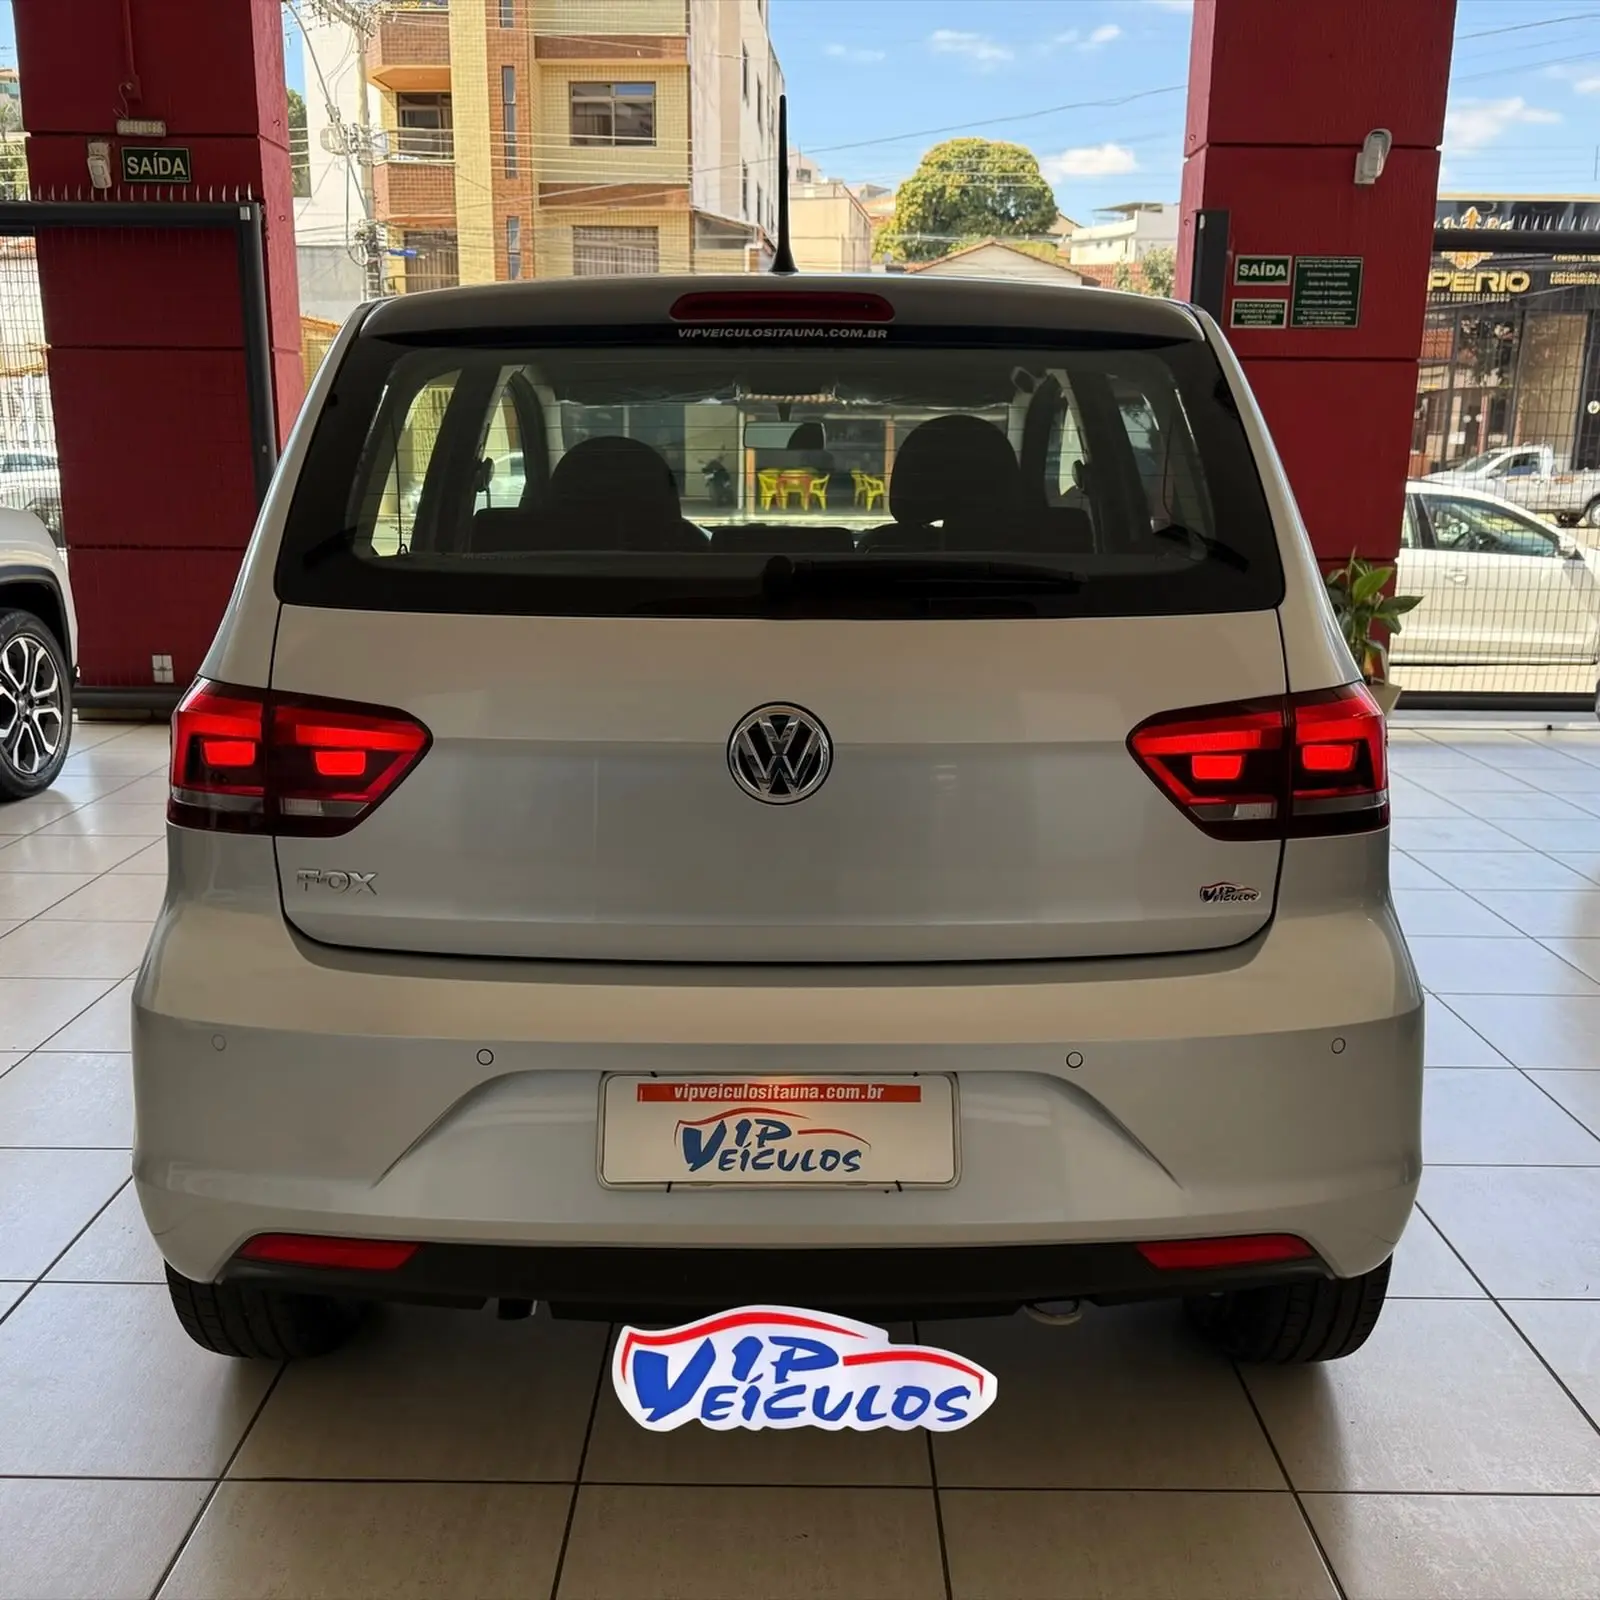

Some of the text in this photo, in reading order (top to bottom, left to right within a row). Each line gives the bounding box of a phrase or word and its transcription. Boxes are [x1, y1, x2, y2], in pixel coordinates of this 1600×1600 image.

[127, 152, 187, 176] SAÍDA
[1239, 261, 1286, 277] SAÍDA
[678, 328, 888, 339] VIPVEICULOSITAUNA.COM.BR
[297, 868, 378, 896] FOX
[674, 1083, 885, 1101] vipveiculositauna.com.br
[683, 1119, 793, 1172] VIP
